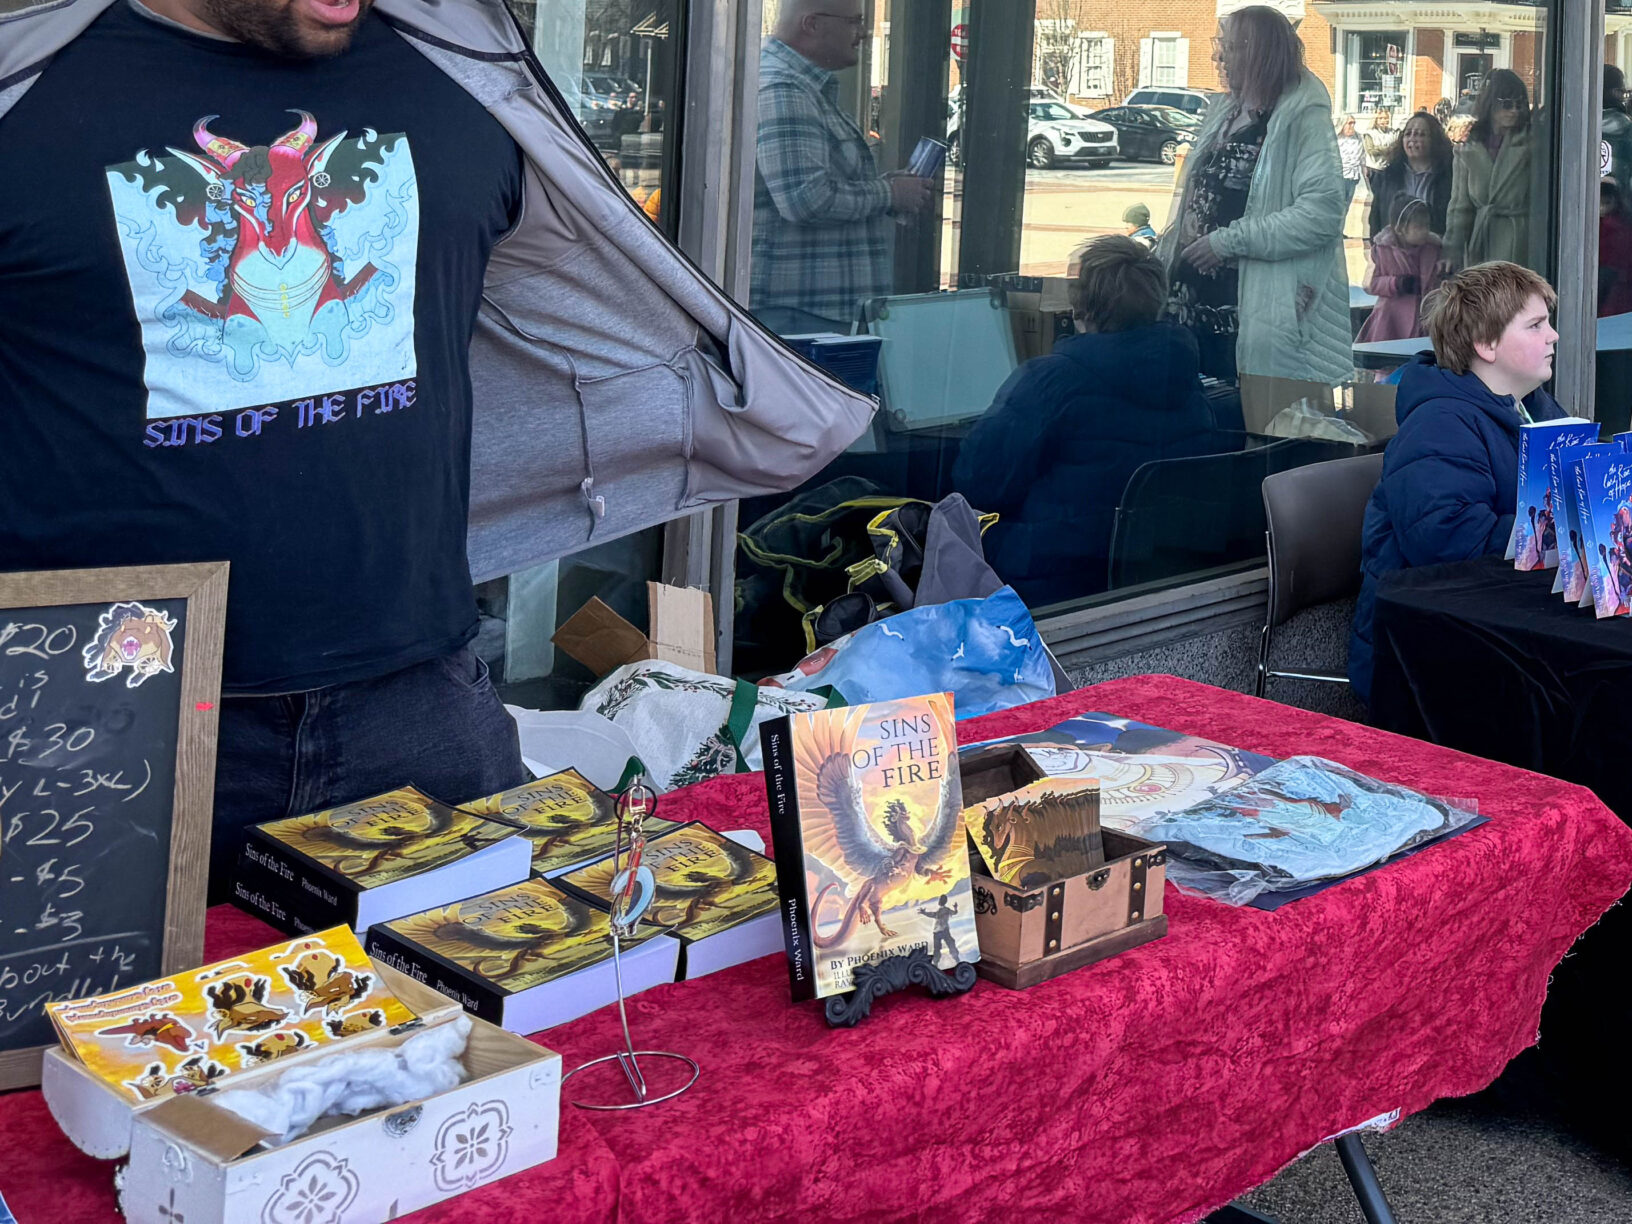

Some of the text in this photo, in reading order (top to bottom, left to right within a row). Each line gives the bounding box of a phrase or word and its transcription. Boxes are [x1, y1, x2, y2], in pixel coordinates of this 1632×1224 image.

[143, 380, 417, 448] SINS OF THE FIRE
[8, 722, 95, 758] $30
[880, 714, 931, 740] SINS
[771, 734, 780, 755] Sins
[852, 737, 941, 769] OF THE
[773, 758, 782, 771] of
[882, 761, 943, 788] FIRE
[777, 792, 786, 815] Fire
[4, 806, 95, 847] $25
[36, 858, 85, 898] $5
[35, 903, 84, 941] $3
[788, 898, 799, 947] Phoenix
[89, 945, 136, 971] the
[793, 948, 804, 981] Ward
[831, 959, 844, 970] BY
[847, 948, 895, 967] PHOENIX
